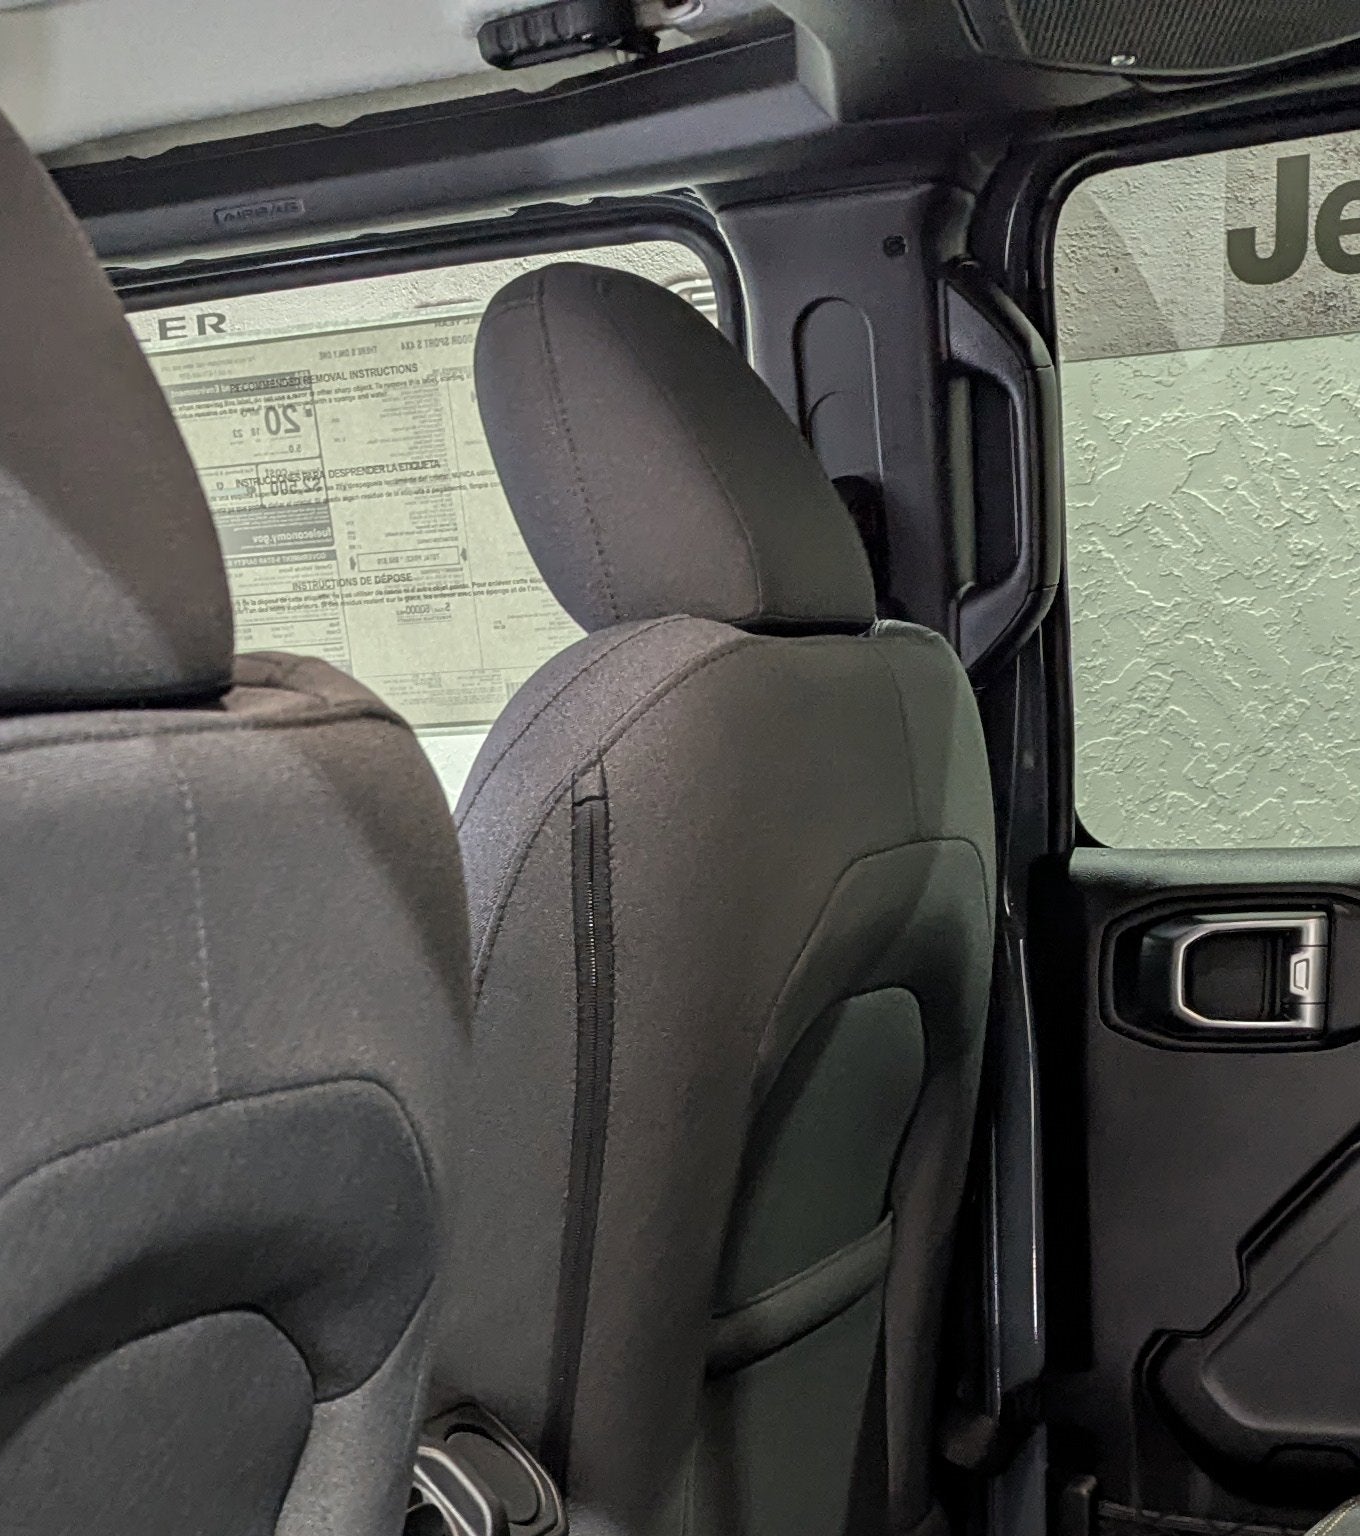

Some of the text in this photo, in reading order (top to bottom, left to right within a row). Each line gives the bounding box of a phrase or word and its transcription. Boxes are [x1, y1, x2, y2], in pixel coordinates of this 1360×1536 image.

[230, 363, 418, 393] RECOMMENDED REMOVAL INSTRUCTIONS
[328, 463, 386, 479] DESPRENDER
[386, 463, 398, 472] LA
[293, 578, 358, 591] INSTRUCTIONS
[360, 576, 373, 586] DE
[375, 573, 413, 584] DÉPOSE
